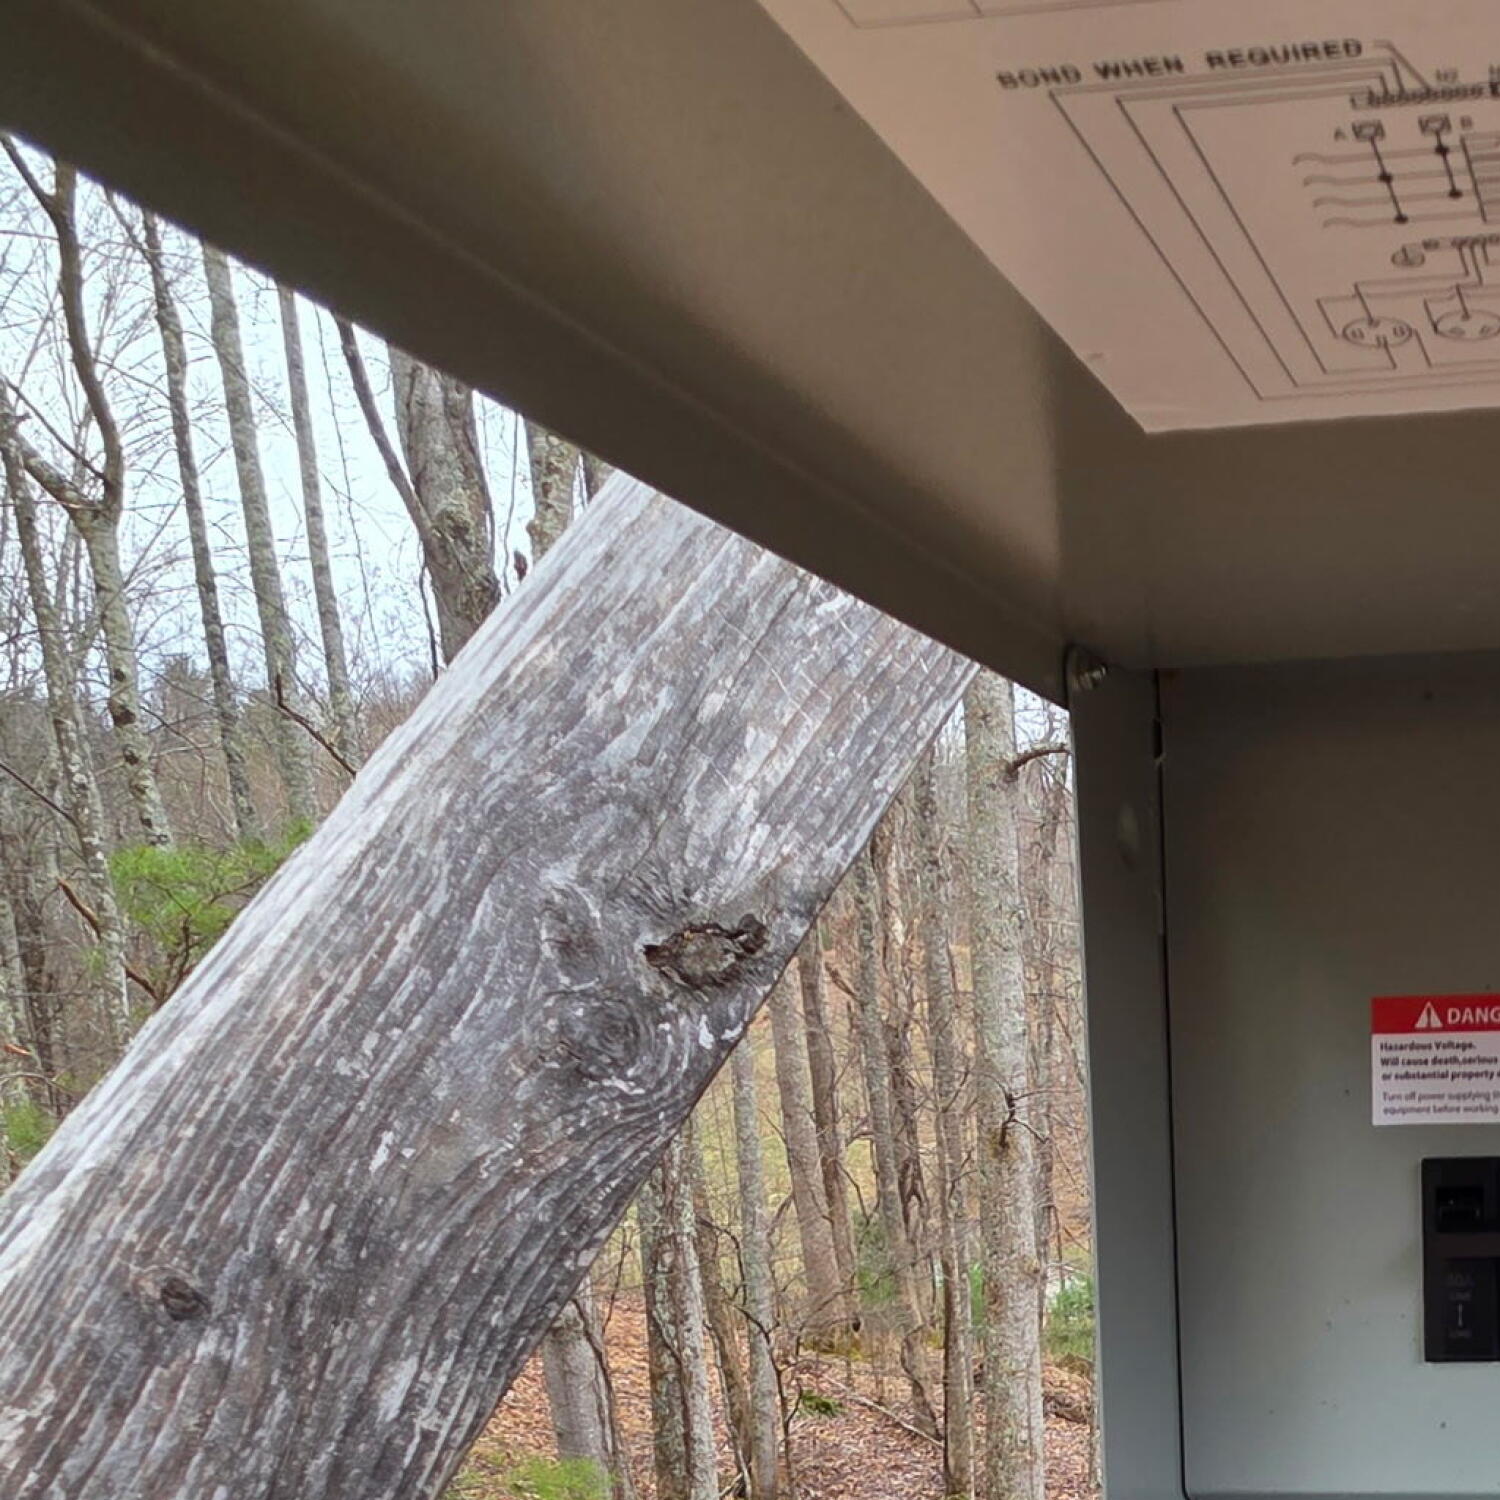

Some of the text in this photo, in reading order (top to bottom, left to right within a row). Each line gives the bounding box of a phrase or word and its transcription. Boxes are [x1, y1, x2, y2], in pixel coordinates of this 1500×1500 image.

[996, 38, 1363, 90] BOND WHEN REQUIRED
[1380, 1040, 1476, 1052] Hazardous Voltage.
[1380, 1057, 1399, 1067] Will
[1401, 1058, 1428, 1067] cause
[1382, 1073, 1392, 1081] or
[1394, 1070, 1448, 1081] substantial
[1451, 1070, 1494, 1082] property
[1383, 1092, 1400, 1101] Turn
[1404, 1091, 1416, 1100] off
[1418, 1093, 1445, 1103] power
[1447, 1091, 1490, 1102] supplying
[1383, 1105, 1430, 1116] equipment
[1433, 1104, 1460, 1113] before
[1463, 1104, 1498, 1115] working
